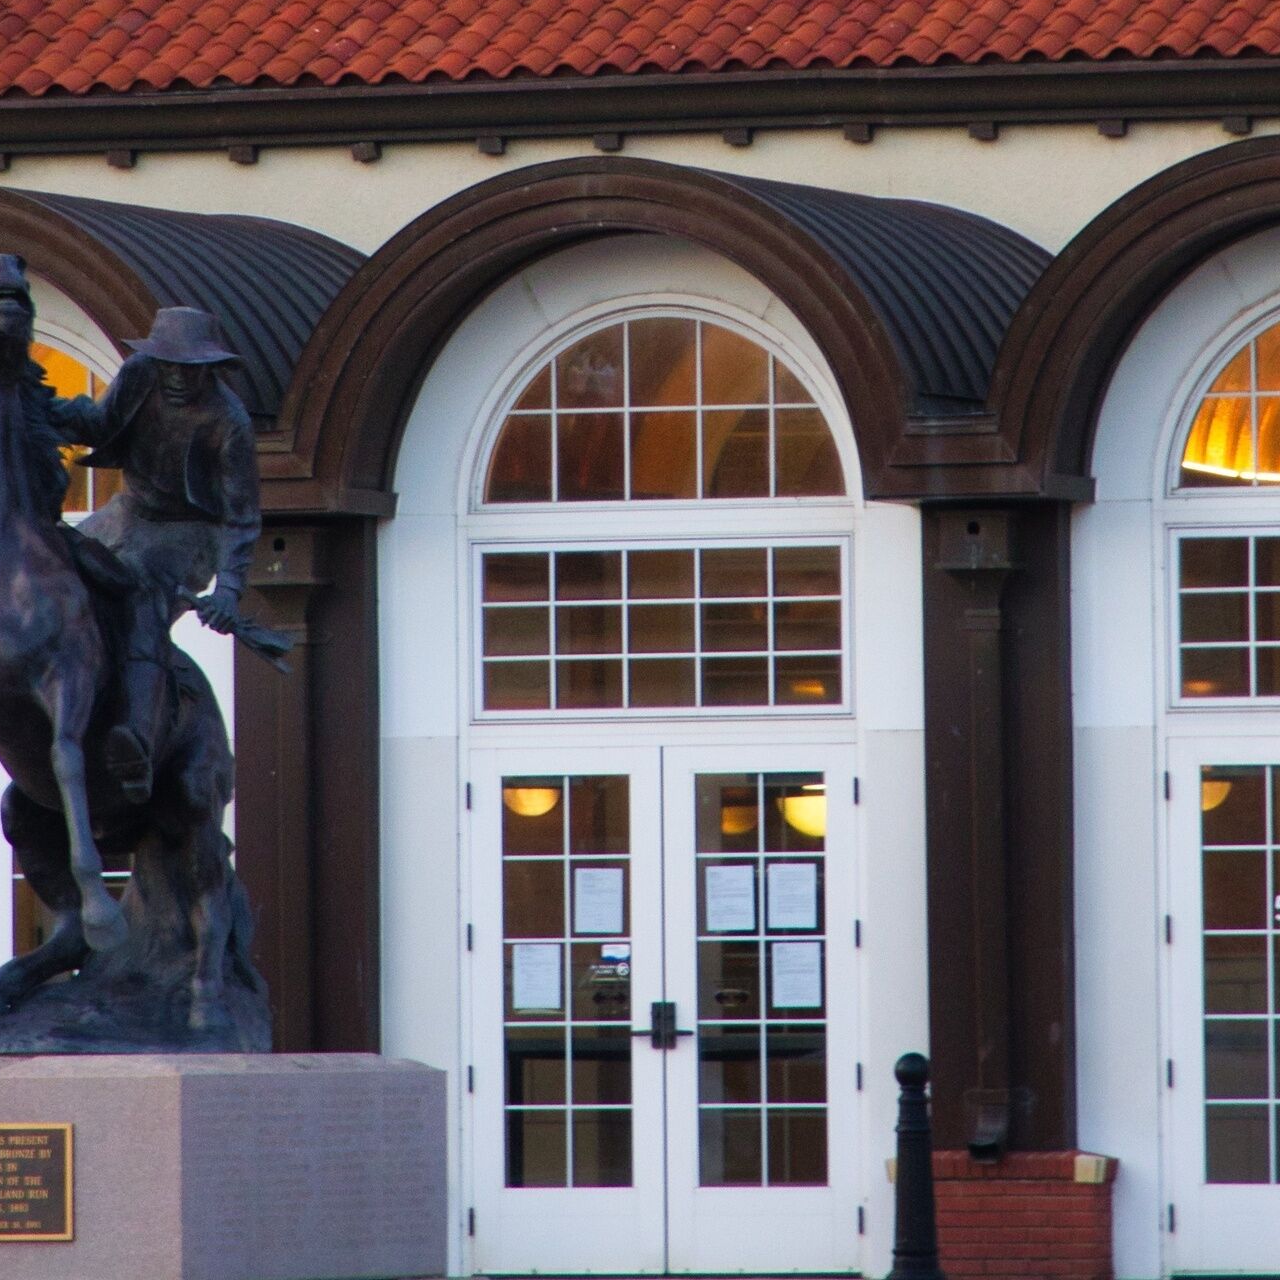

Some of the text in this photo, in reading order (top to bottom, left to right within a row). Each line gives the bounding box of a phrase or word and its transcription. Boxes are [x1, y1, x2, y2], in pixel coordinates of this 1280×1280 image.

[10, 1135, 48, 1145] PRESENT
[0, 1150, 35, 1159] BRONZE
[40, 1150, 52, 1158] BY
[7, 1164, 17, 1172] IN
[8, 1176, 20, 1185] OF
[25, 1176, 42, 1185] THE
[0, 1190, 24, 1199] LAND
[30, 1190, 48, 1199] RUN
